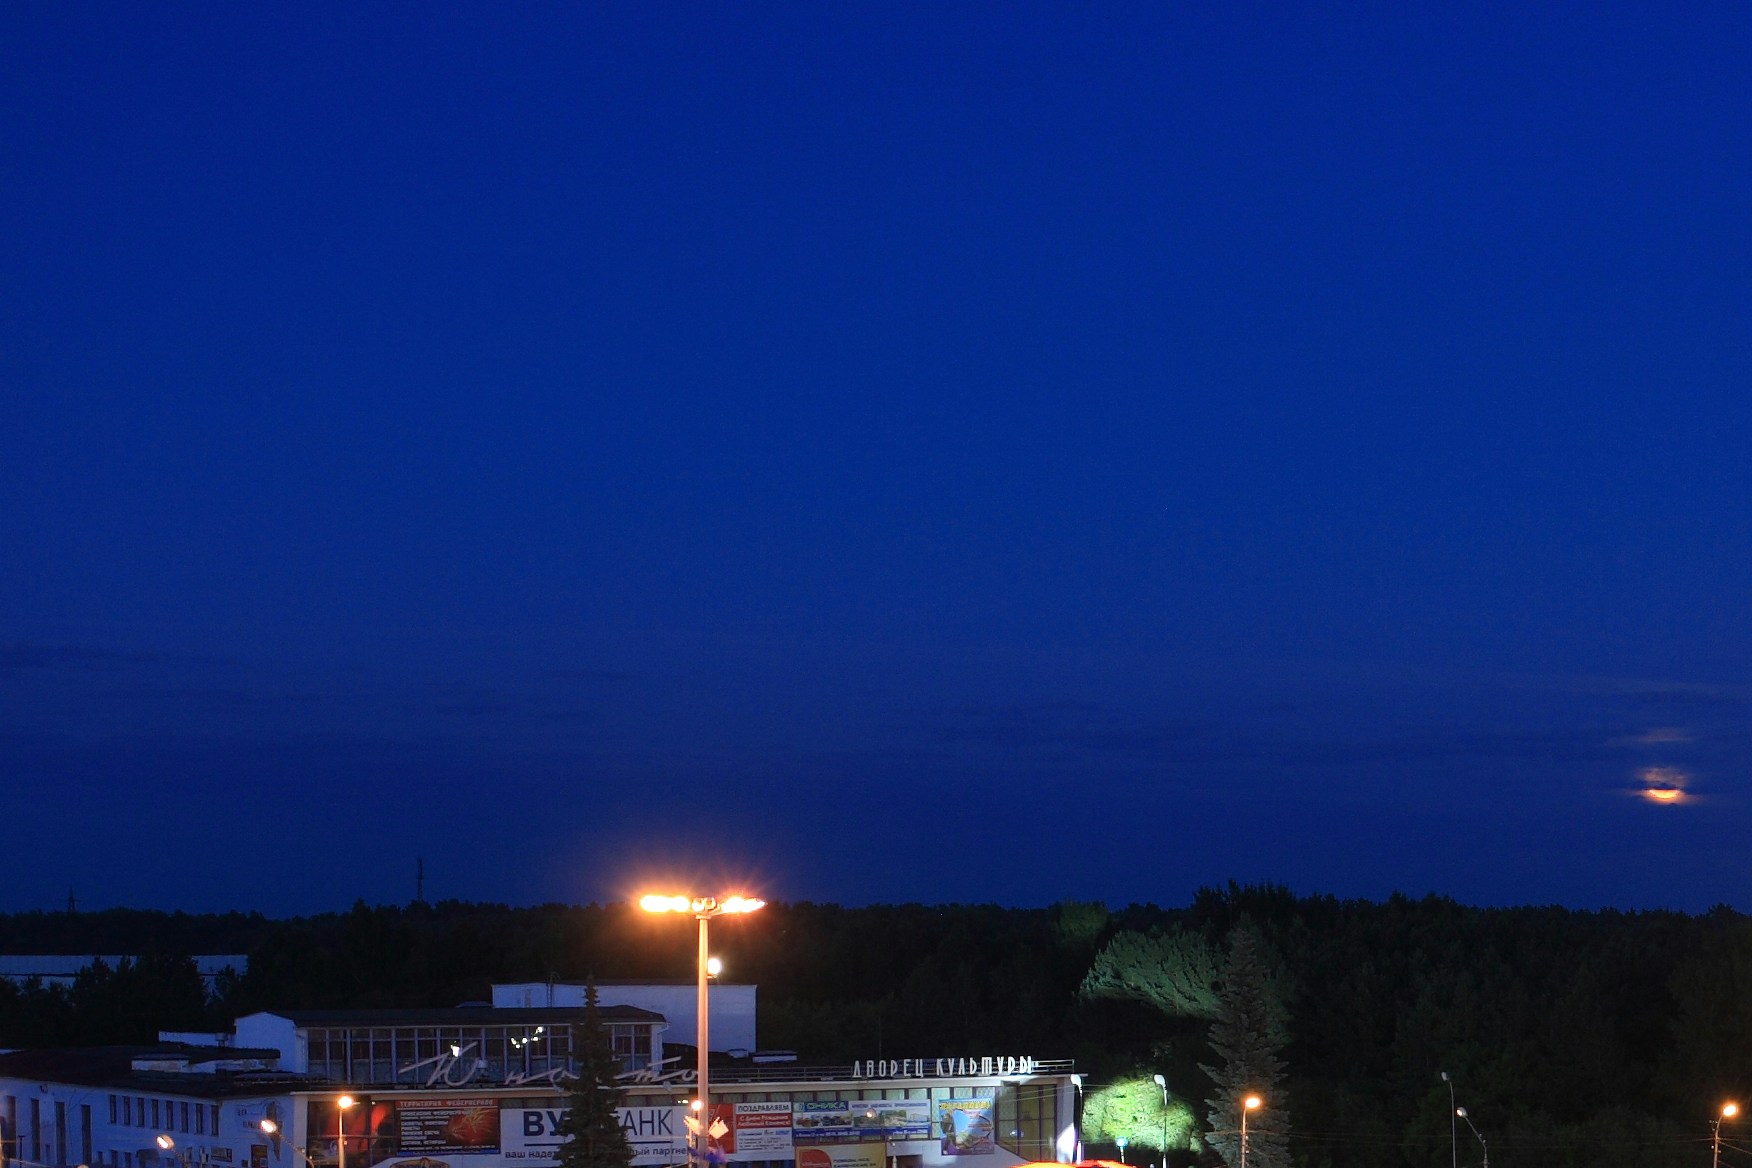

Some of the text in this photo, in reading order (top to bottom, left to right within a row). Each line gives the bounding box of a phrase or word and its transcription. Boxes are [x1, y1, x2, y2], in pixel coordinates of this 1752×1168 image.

[852, 1056, 1032, 1079] ДВОРЕЦ КУЛЬТУРЫ
[738, 1104, 790, 1113] ПОЗДРАВЛЯЕМ
[505, 1151, 526, 1159] ваш
